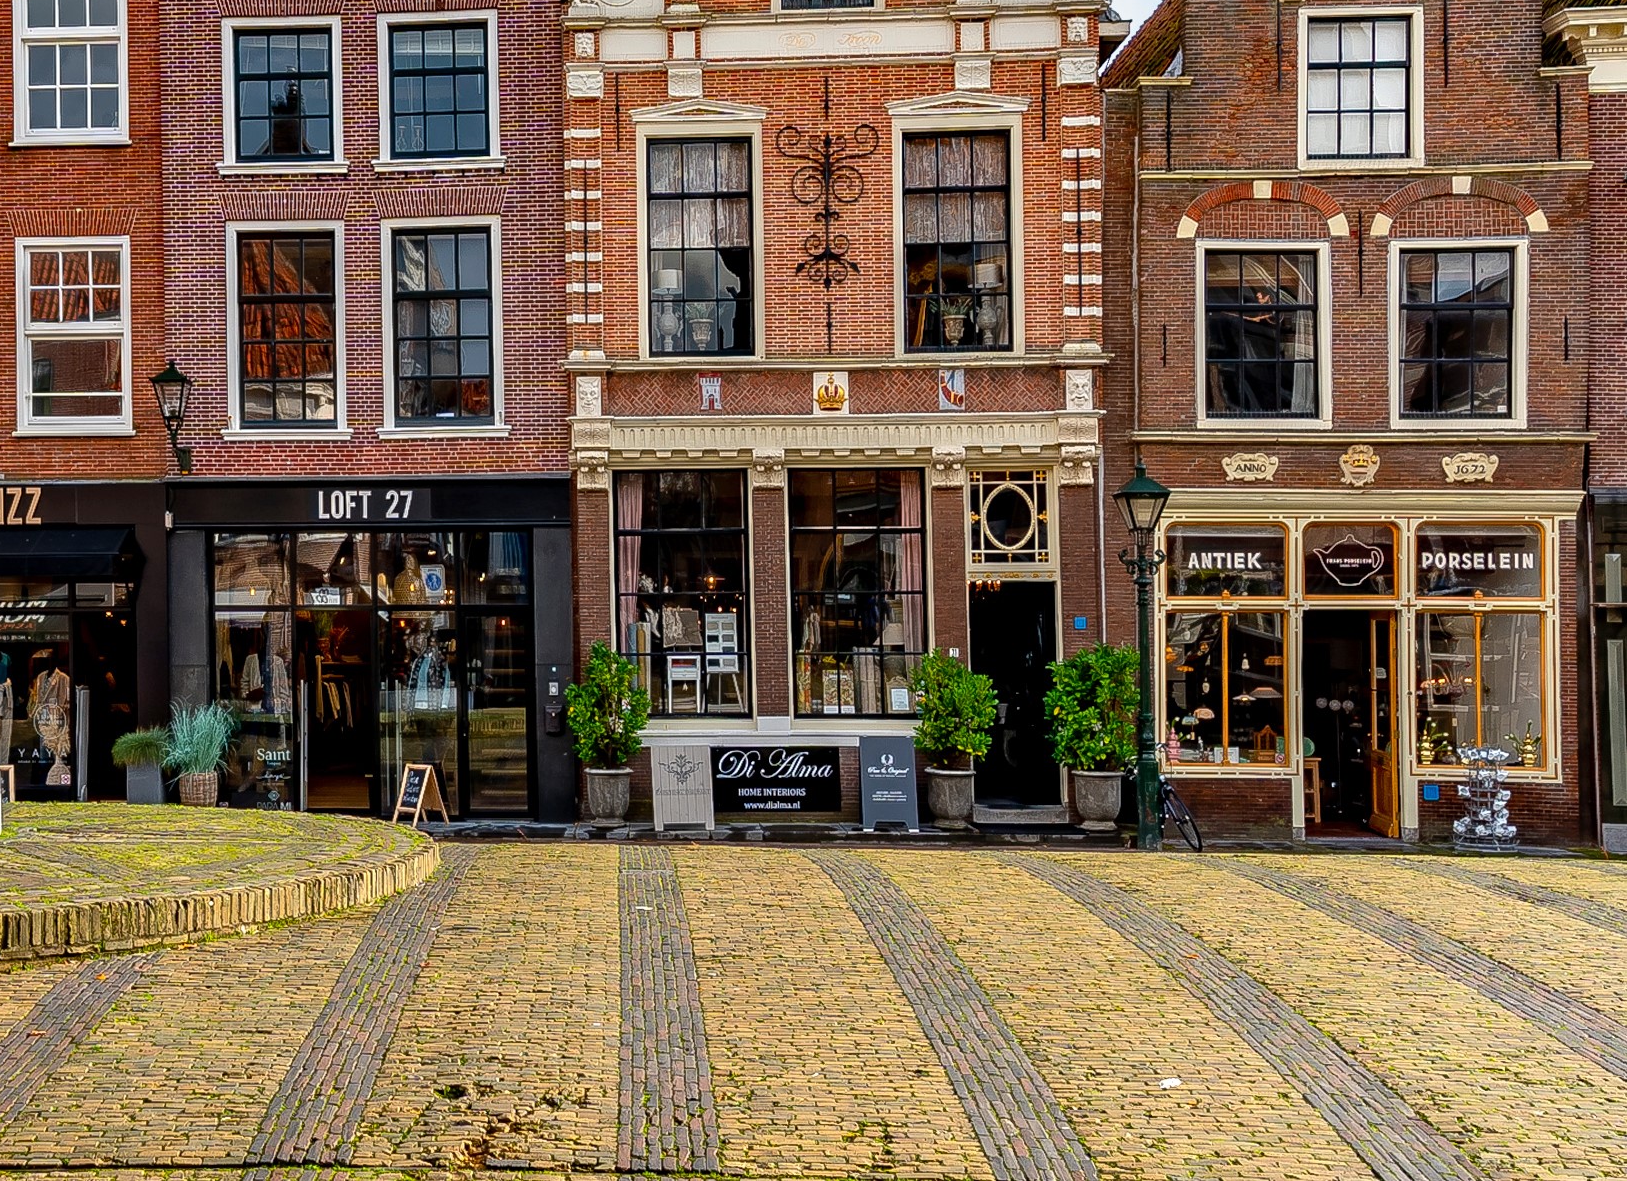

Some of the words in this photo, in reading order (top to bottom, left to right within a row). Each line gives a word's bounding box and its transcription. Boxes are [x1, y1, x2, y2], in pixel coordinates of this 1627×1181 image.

[1233, 463, 1267, 474] ANNO
[318, 490, 372, 519] LOFT
[385, 490, 413, 519] 27
[1188, 552, 1262, 570] ANTIEK
[1420, 552, 1534, 570] PORSELEIN
[256, 747, 292, 760] Saint
[716, 749, 760, 778] Di
[760, 749, 833, 778] Alma
[738, 788, 762, 796] HOME
[763, 788, 806, 796] INTERIORS
[743, 800, 801, 809] www.dialma.nl
